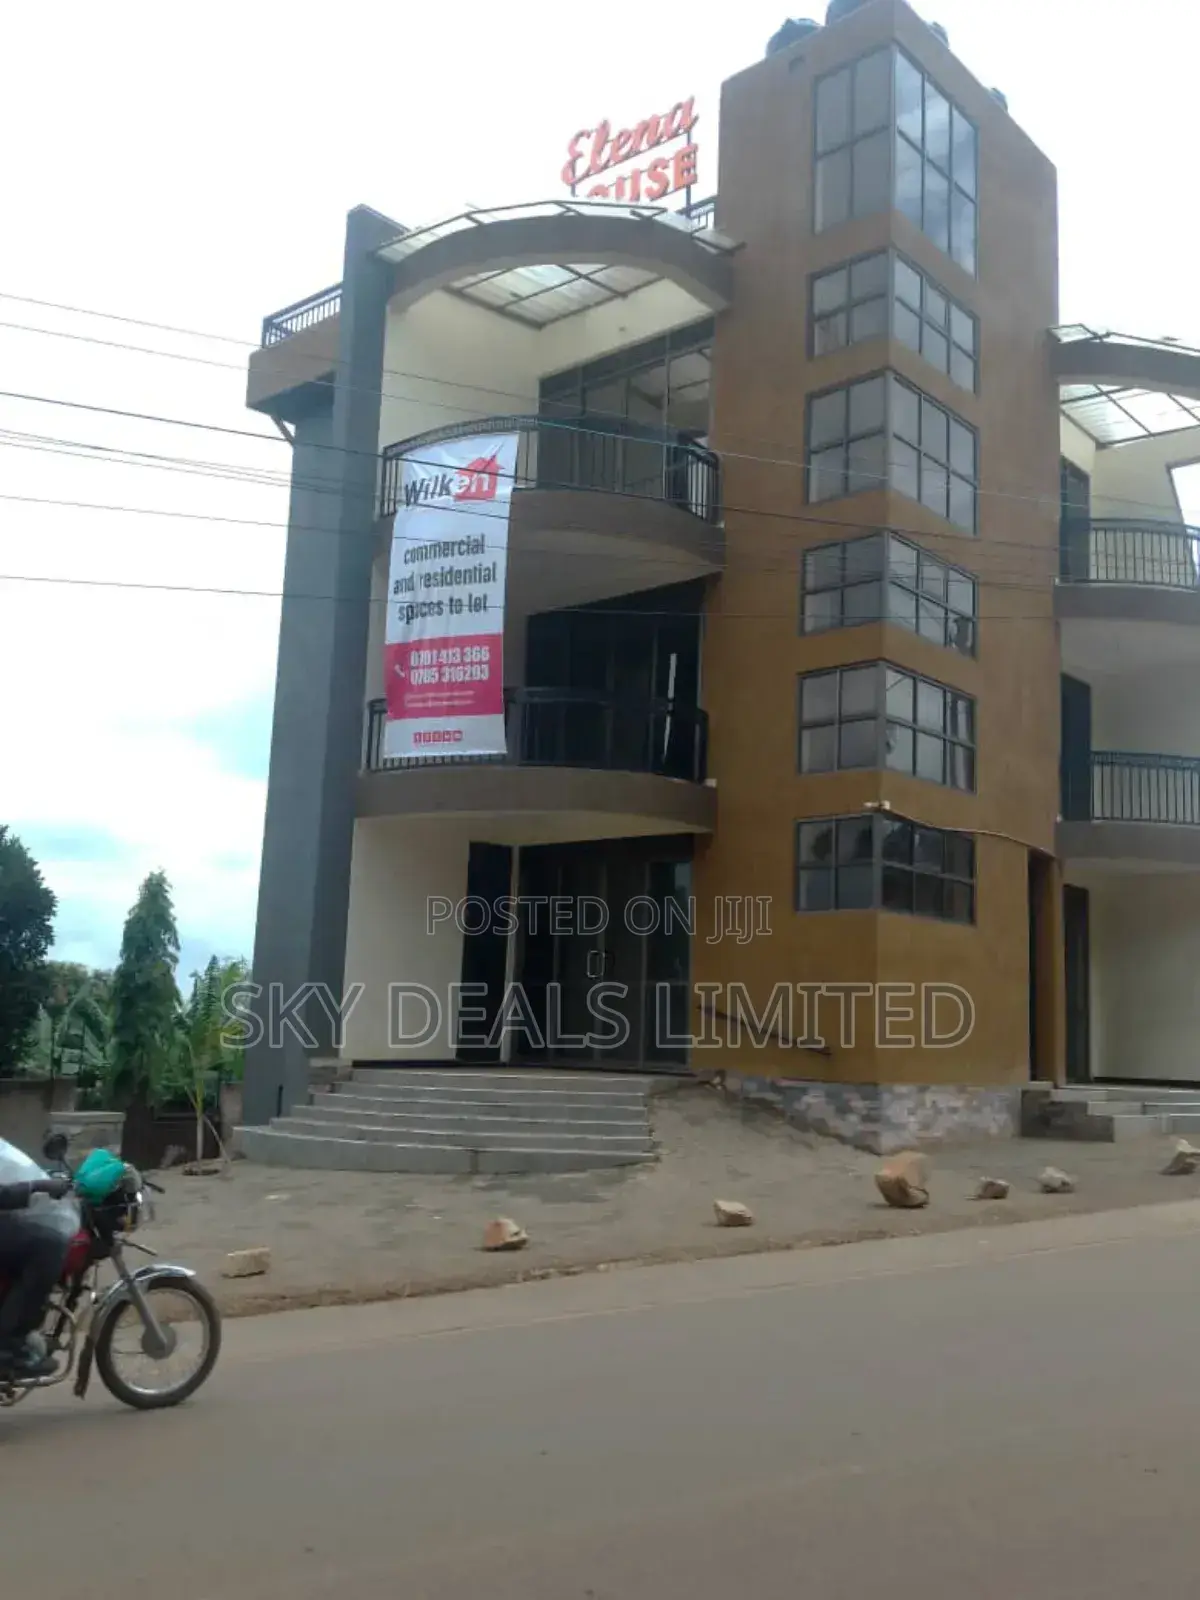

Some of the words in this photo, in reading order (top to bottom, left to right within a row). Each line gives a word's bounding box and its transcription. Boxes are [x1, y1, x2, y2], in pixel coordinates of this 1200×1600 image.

[404, 469, 491, 508] Wilken
[403, 532, 486, 565] commercial
[393, 571, 416, 595] and
[419, 561, 498, 590] residential
[449, 596, 464, 615] to
